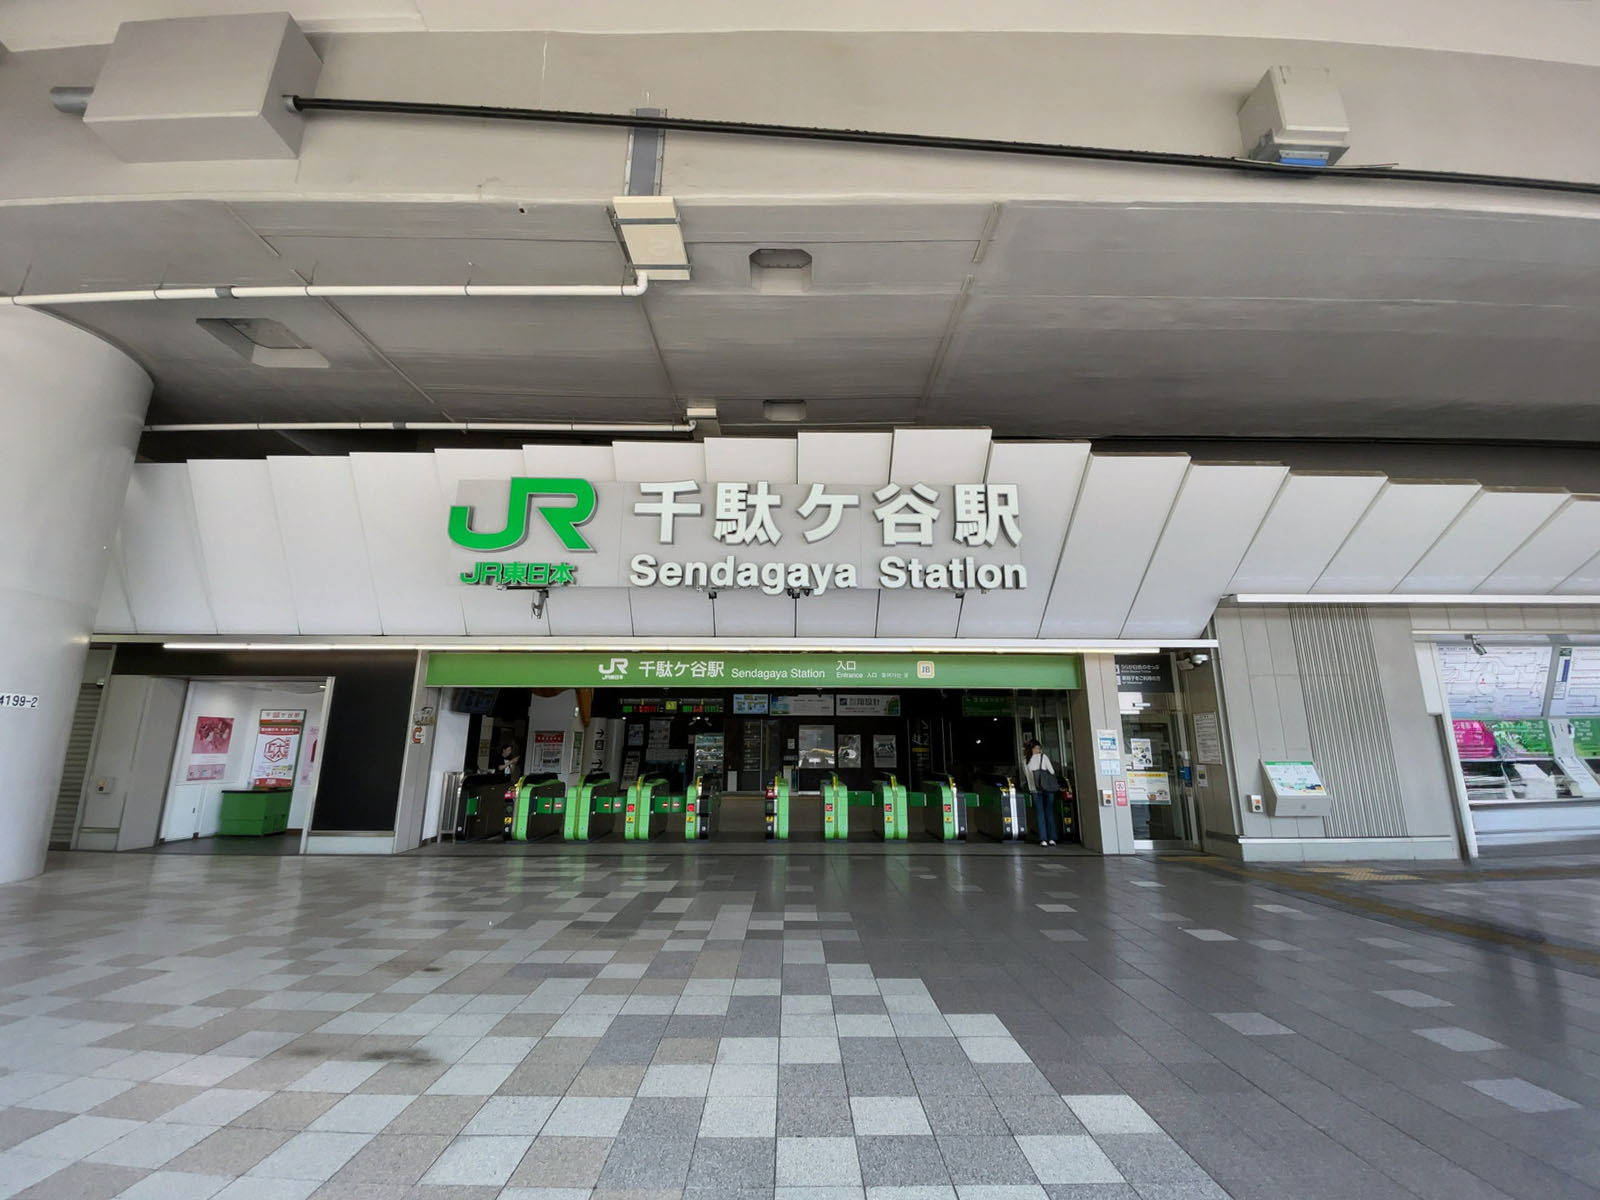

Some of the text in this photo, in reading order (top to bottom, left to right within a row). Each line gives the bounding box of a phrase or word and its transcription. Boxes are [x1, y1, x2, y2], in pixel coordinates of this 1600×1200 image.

[448, 477, 598, 552] JR
[633, 479, 1022, 547] 千駄ケ谷駅
[459, 561, 576, 585] JR東日本
[629, 553, 1028, 596] Sendagaya Station
[598, 657, 629, 675] JR
[638, 660, 725, 678] 千駄ケ谷駅
[731, 667, 825, 680] Sendagaya Station
[836, 660, 856, 671] 入口
